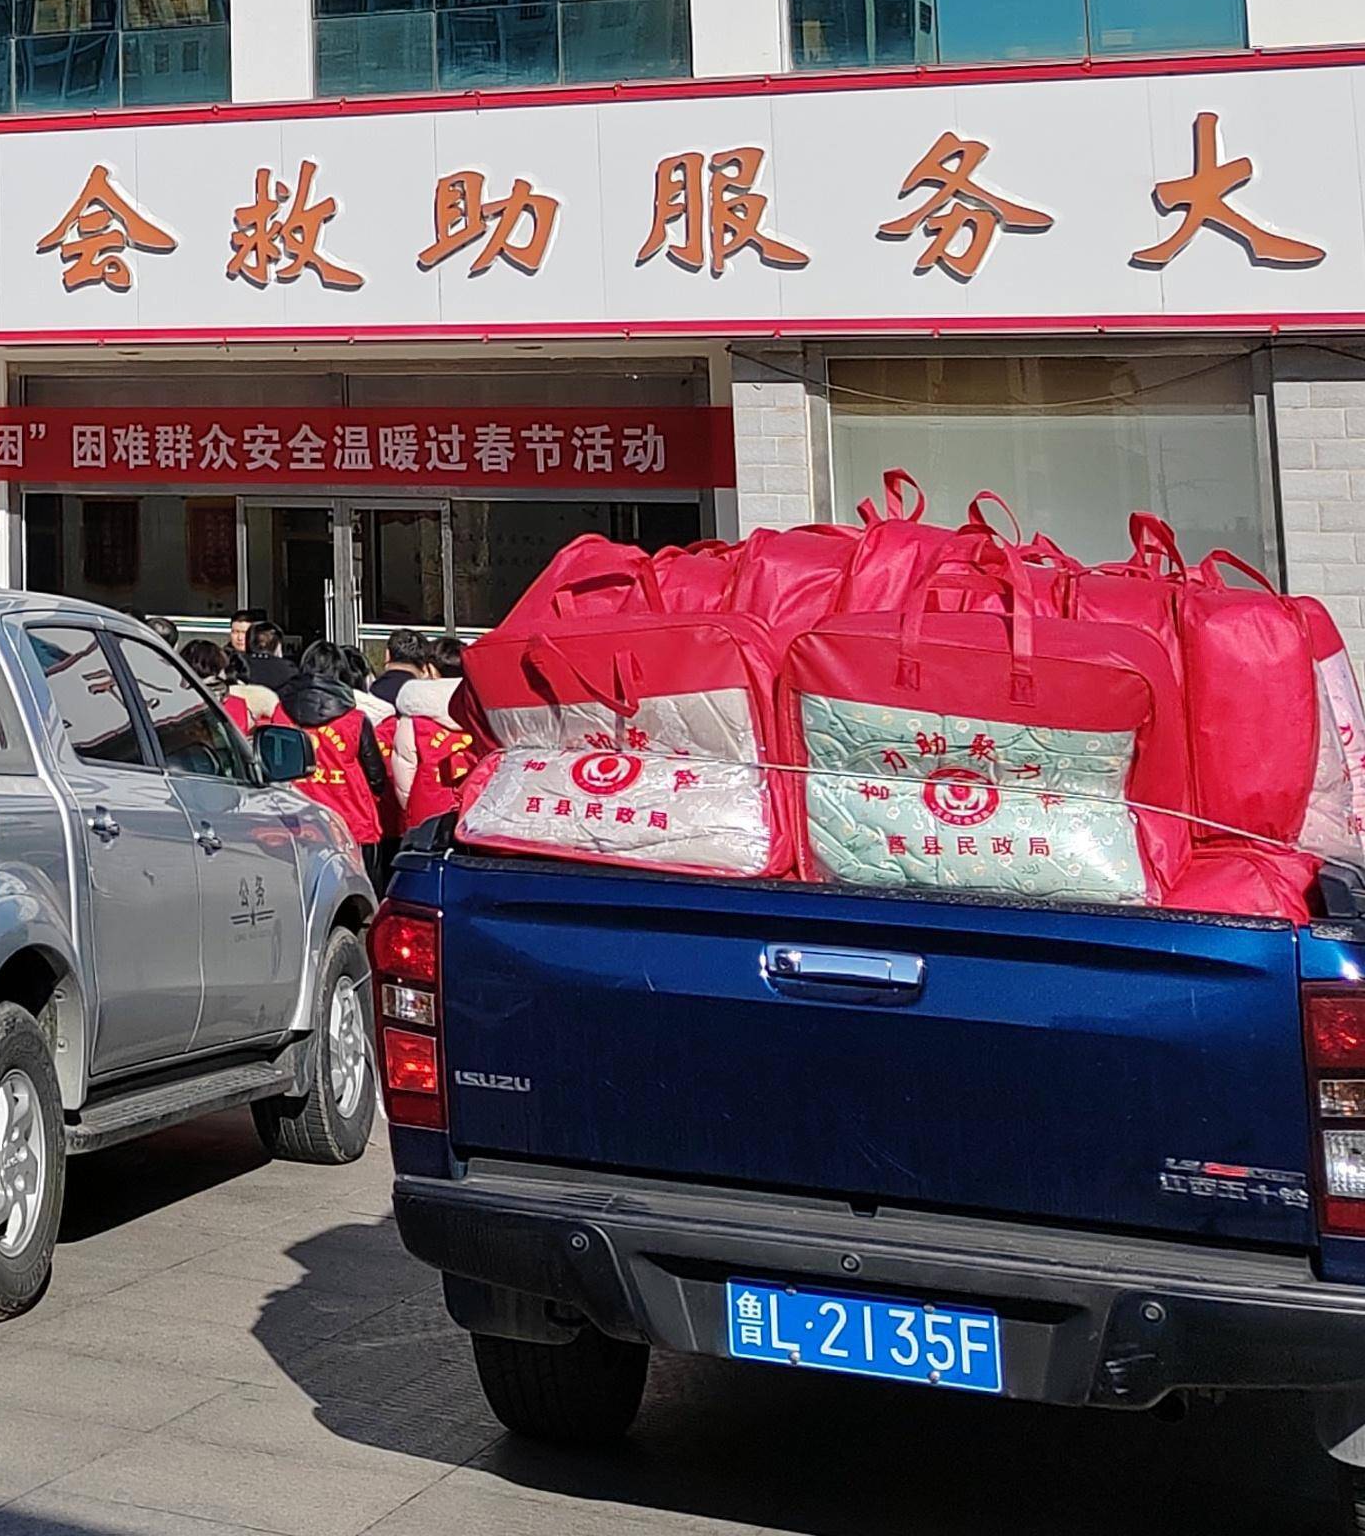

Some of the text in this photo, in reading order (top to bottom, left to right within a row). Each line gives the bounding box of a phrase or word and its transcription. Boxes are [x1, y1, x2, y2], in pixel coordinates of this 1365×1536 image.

[72, 422, 666, 475] 困难群众安全温暖过春节活动
[525, 795, 669, 831] 莒县民政局
[886, 834, 1052, 858] 莒县民政局
[455, 1070, 531, 1093] ISUZU
[1159, 1172, 1309, 1209] 江西五十铃
